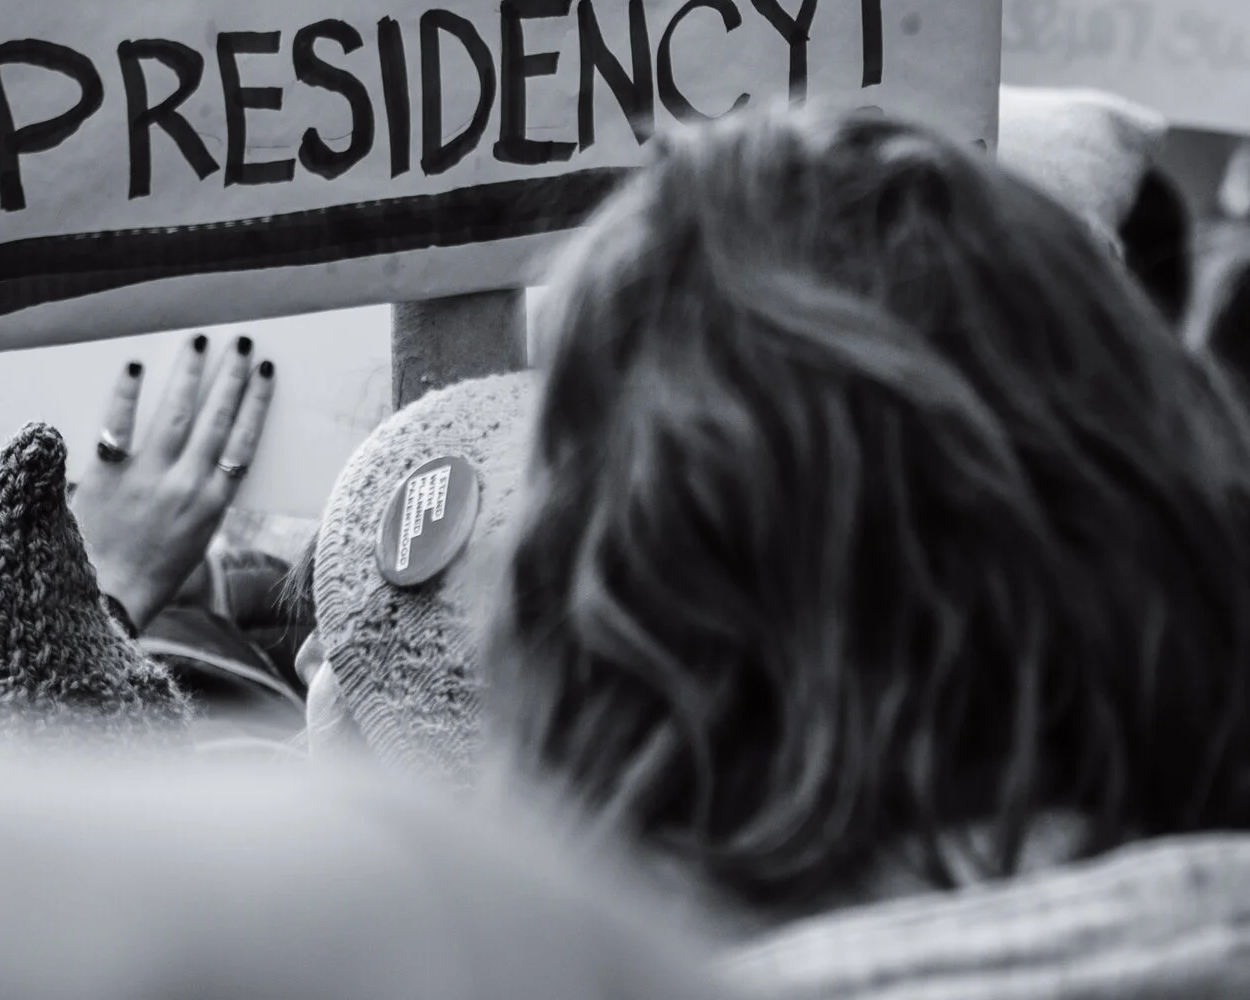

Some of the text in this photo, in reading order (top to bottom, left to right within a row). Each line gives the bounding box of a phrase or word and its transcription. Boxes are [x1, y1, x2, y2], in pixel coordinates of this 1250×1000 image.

[413, 476, 427, 535] PLANNED
[426, 474, 437, 507] WITH
[434, 475, 448, 518] STAND
[400, 480, 417, 566] PARENTHOOD
